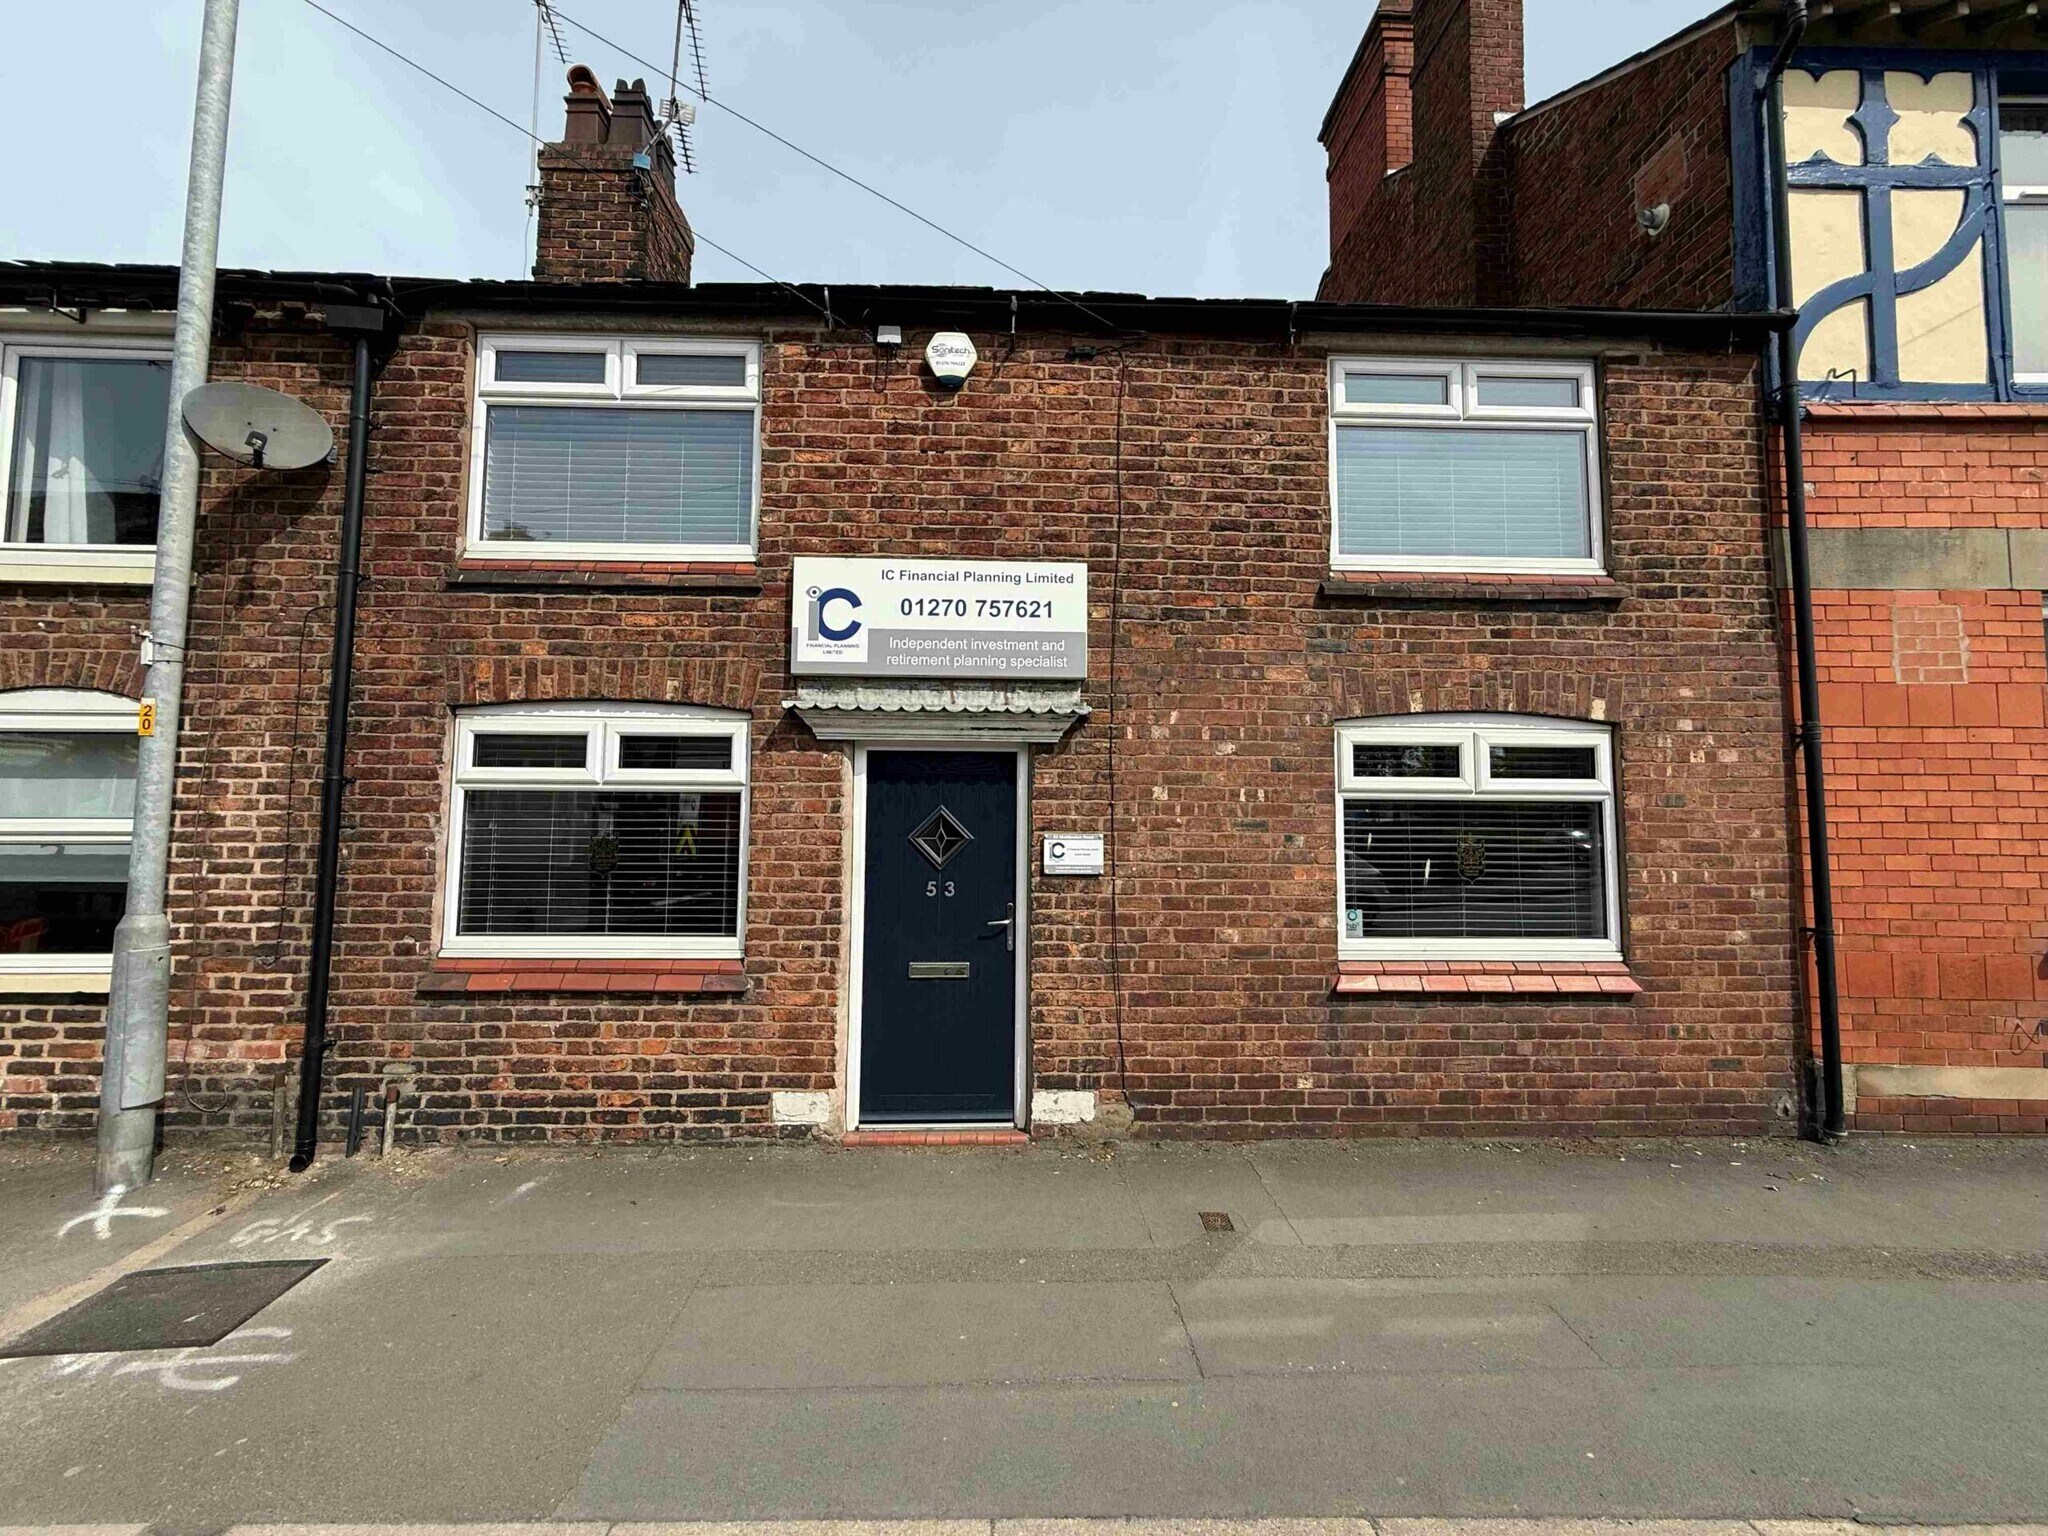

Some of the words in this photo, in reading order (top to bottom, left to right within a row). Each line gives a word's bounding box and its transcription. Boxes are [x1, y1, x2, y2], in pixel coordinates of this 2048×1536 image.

[881, 569, 895, 581] IC
[899, 570, 959, 581] Financial
[963, 571, 1022, 585] Planning
[1026, 573, 1074, 584] Limited
[900, 598, 967, 617] 01270
[975, 599, 1052, 618] 757621
[889, 636, 968, 651] Independent
[971, 638, 1039, 651] investment
[1042, 640, 1065, 651] and
[886, 653, 950, 666] retirement
[953, 654, 1007, 669] planning
[1010, 656, 1068, 669] specialist
[925, 881, 955, 897] 53
